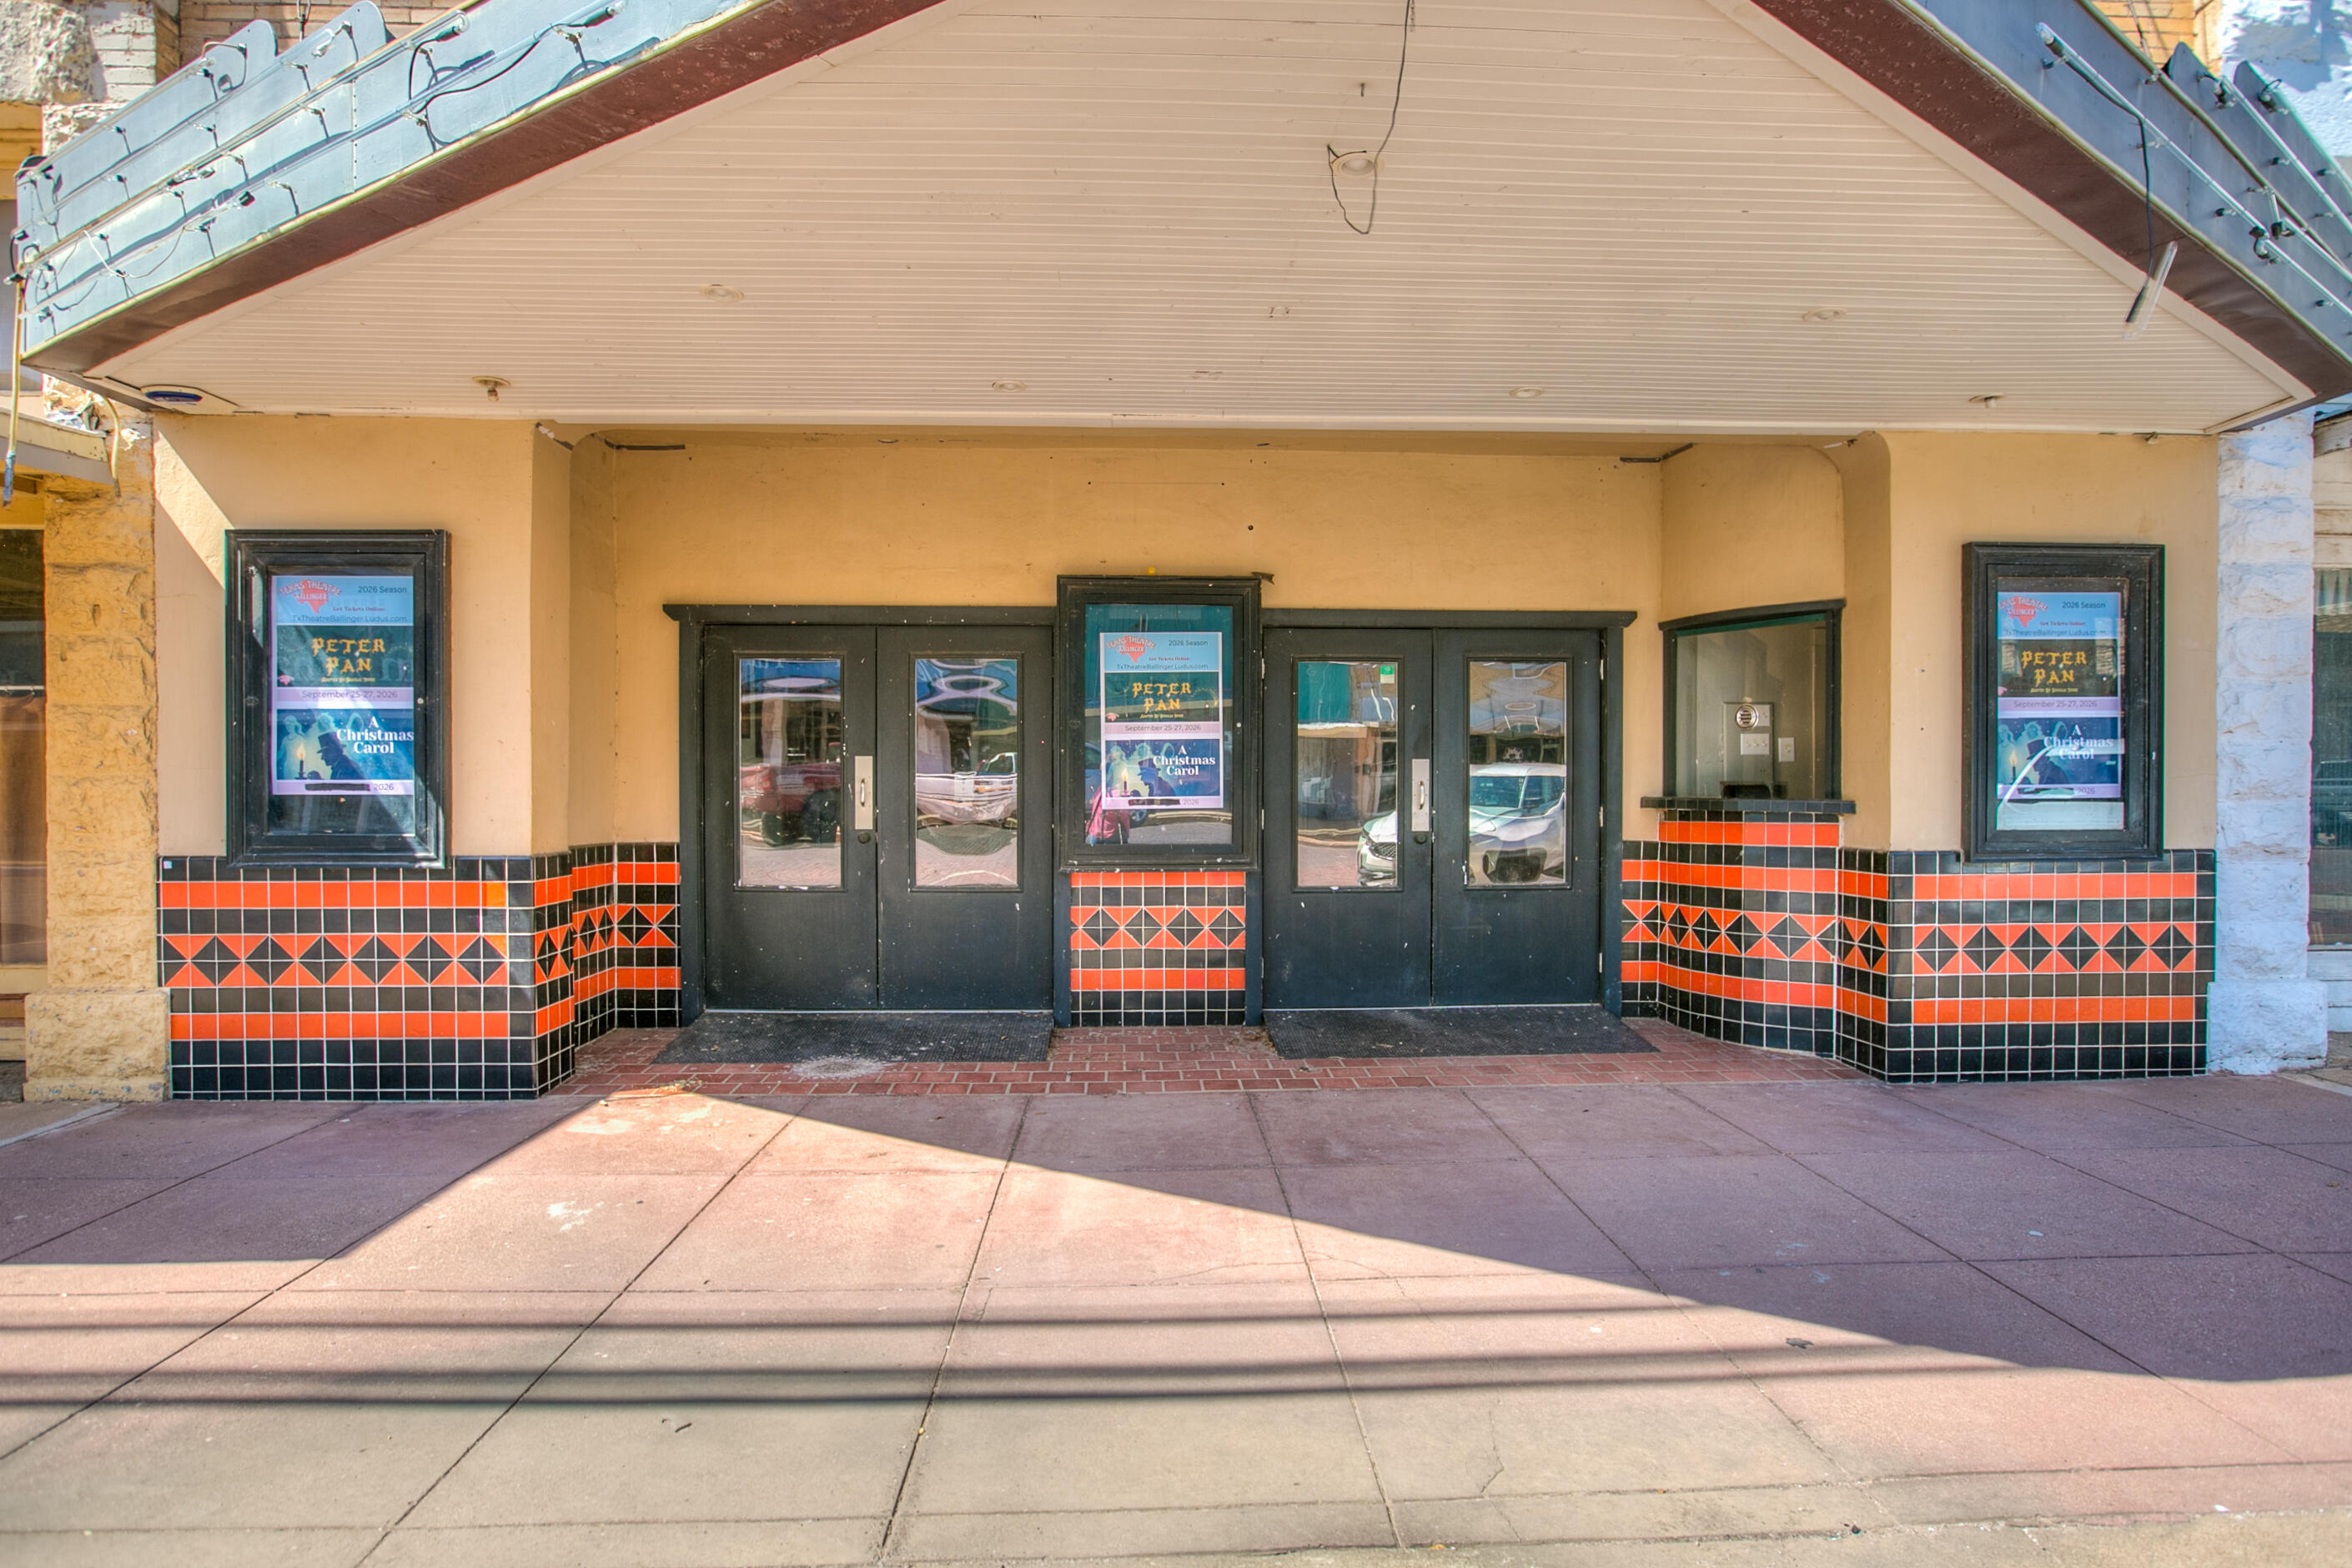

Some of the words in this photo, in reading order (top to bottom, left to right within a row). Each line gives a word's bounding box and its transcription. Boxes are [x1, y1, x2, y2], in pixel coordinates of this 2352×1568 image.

[311, 637, 385, 656] PETER
[325, 656, 371, 676] PAN
[2022, 651, 2087, 669] PETER
[2034, 668, 2075, 686] PAN
[302, 691, 349, 700] September
[376, 691, 398, 699] 2026
[1132, 682, 1191, 698] PETER
[1143, 697, 1180, 713] PAN
[2013, 701, 2055, 709] September
[369, 716, 379, 728] A
[336, 728, 415, 741] Christmas
[2072, 724, 2082, 736] A
[354, 741, 395, 754] Carol
[2043, 736, 2114, 748] Christmas
[1178, 745, 1187, 755] A
[2058, 748, 2095, 760] Carol
[1153, 755, 1216, 765] Christmas
[1166, 766, 1199, 776] Carol
